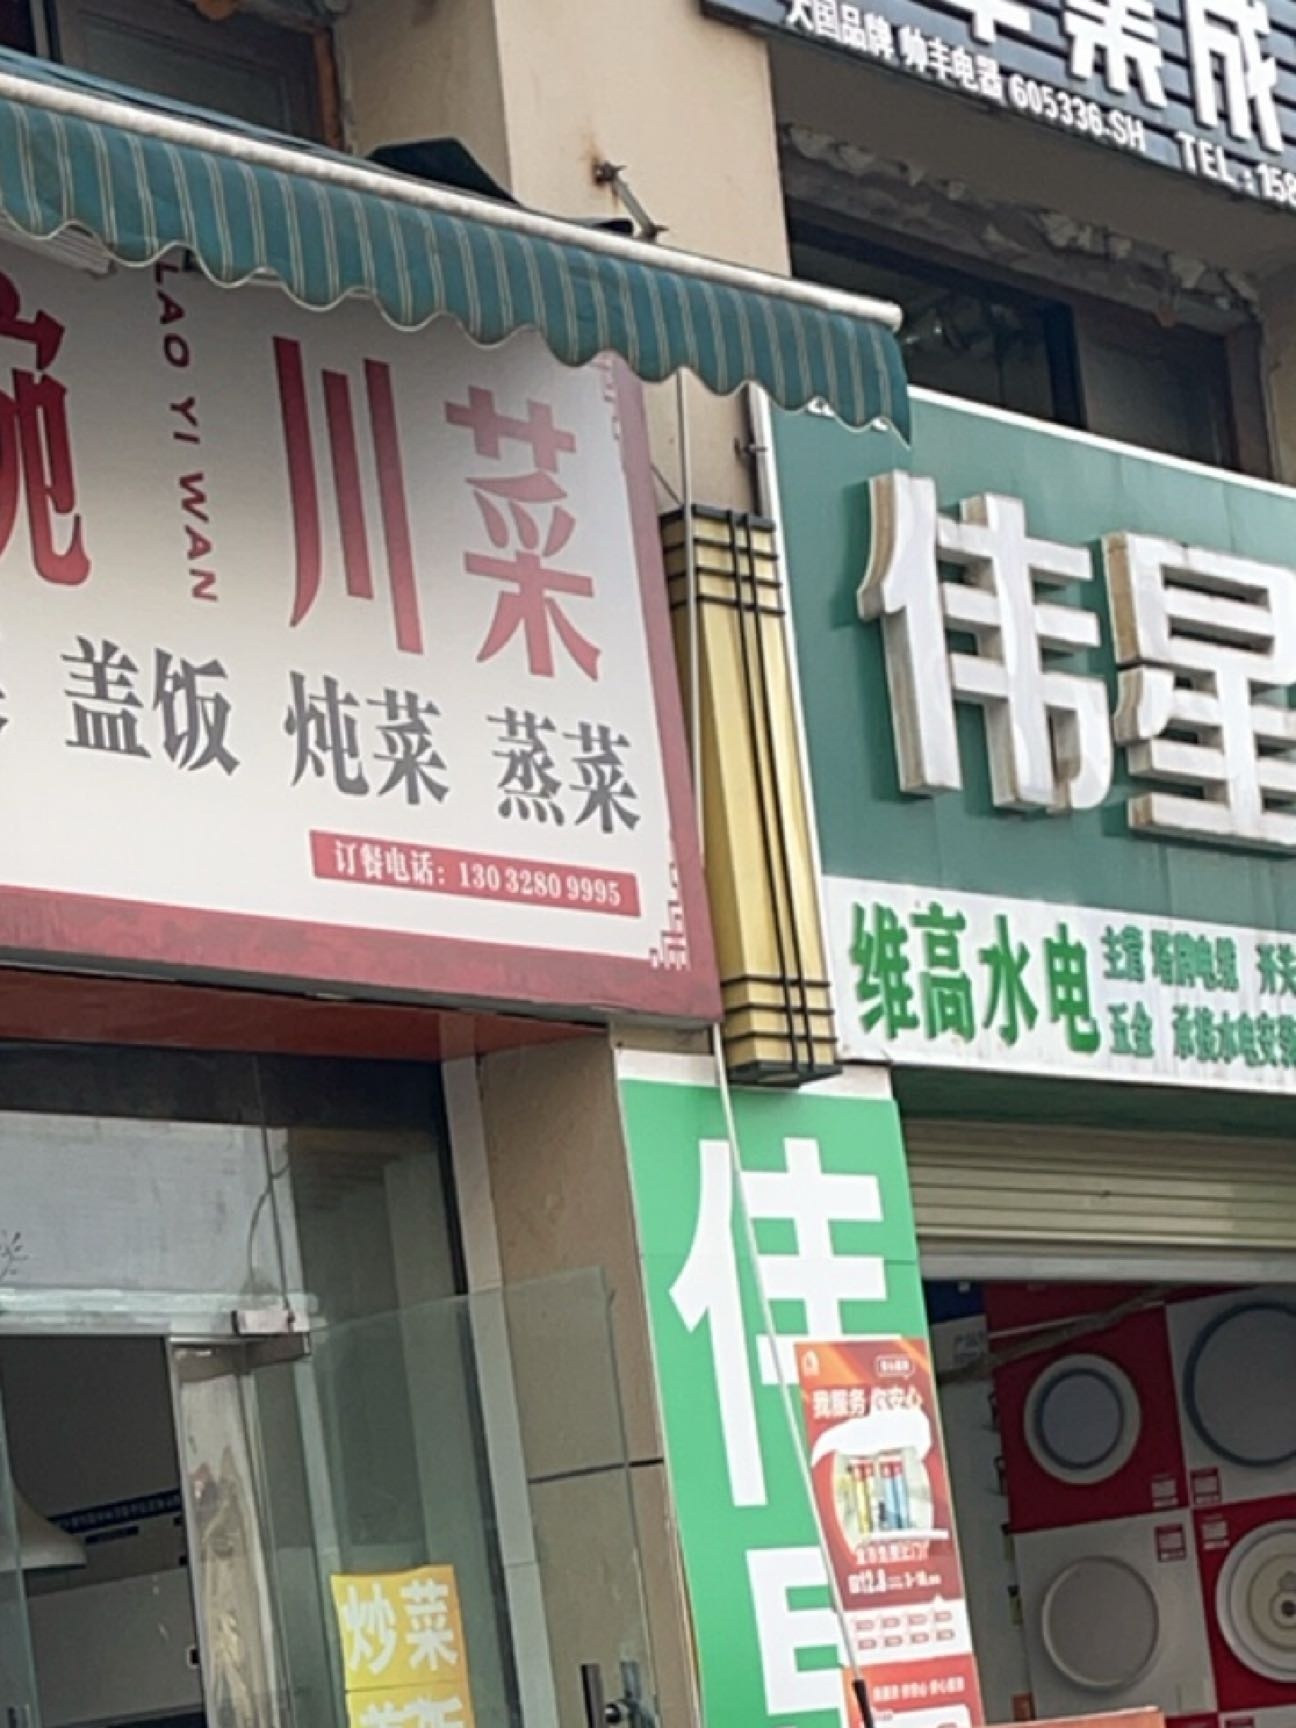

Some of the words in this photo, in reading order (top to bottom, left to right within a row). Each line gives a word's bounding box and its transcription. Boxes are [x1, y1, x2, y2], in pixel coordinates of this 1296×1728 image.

[179, 472, 219, 603] WAN
[272, 335, 603, 683] 川菜
[60, 635, 240, 777] 盖饭
[282, 670, 450, 805] 炖菜
[484, 705, 641, 834] 蒸菜
[857, 468, 1296, 854] 伟星
[851, 901, 1102, 1056] 维高水电
[341, 1579, 459, 1676] 炒菜
